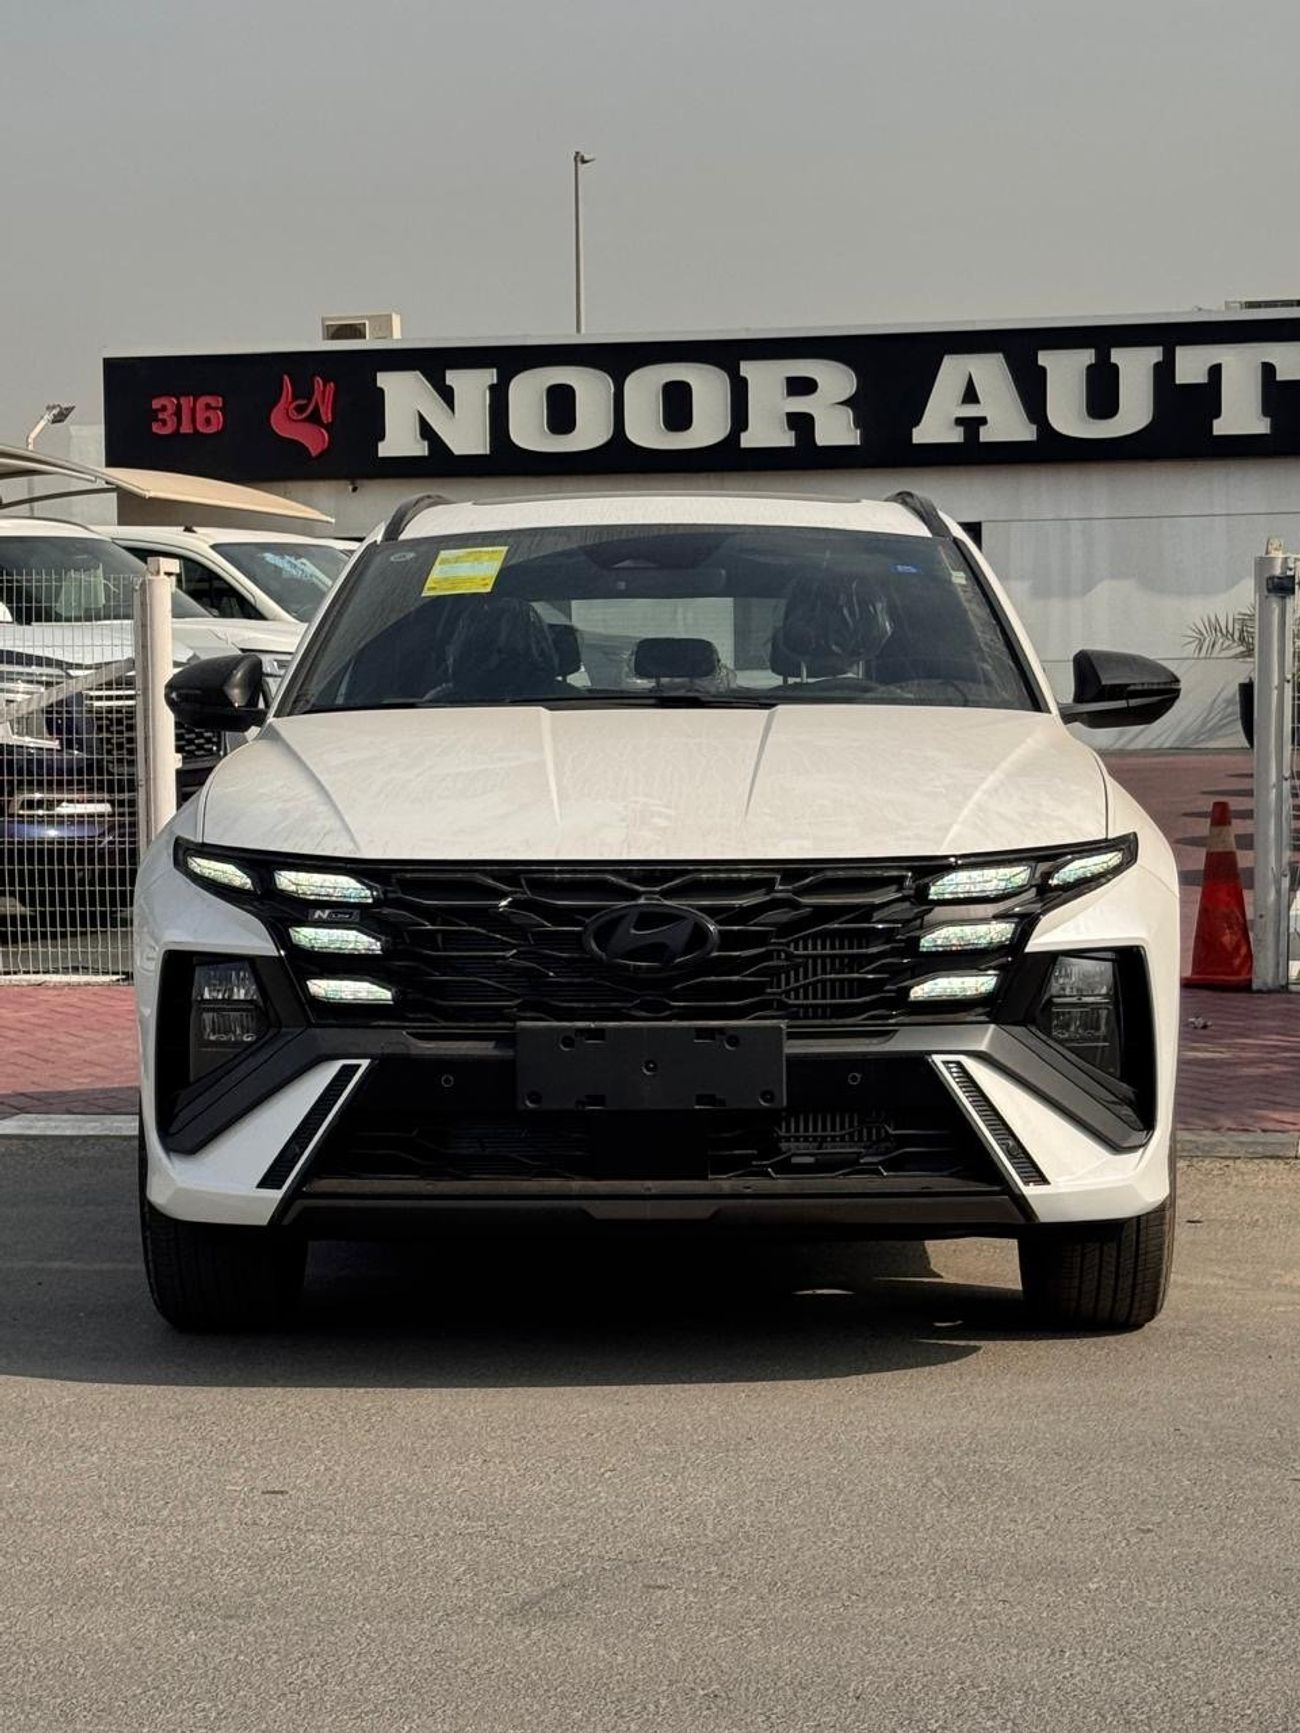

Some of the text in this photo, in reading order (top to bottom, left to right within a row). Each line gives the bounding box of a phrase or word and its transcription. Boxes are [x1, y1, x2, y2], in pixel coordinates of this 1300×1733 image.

[151, 395, 224, 435] 316
[376, 341, 1300, 458] NOOR AUT
